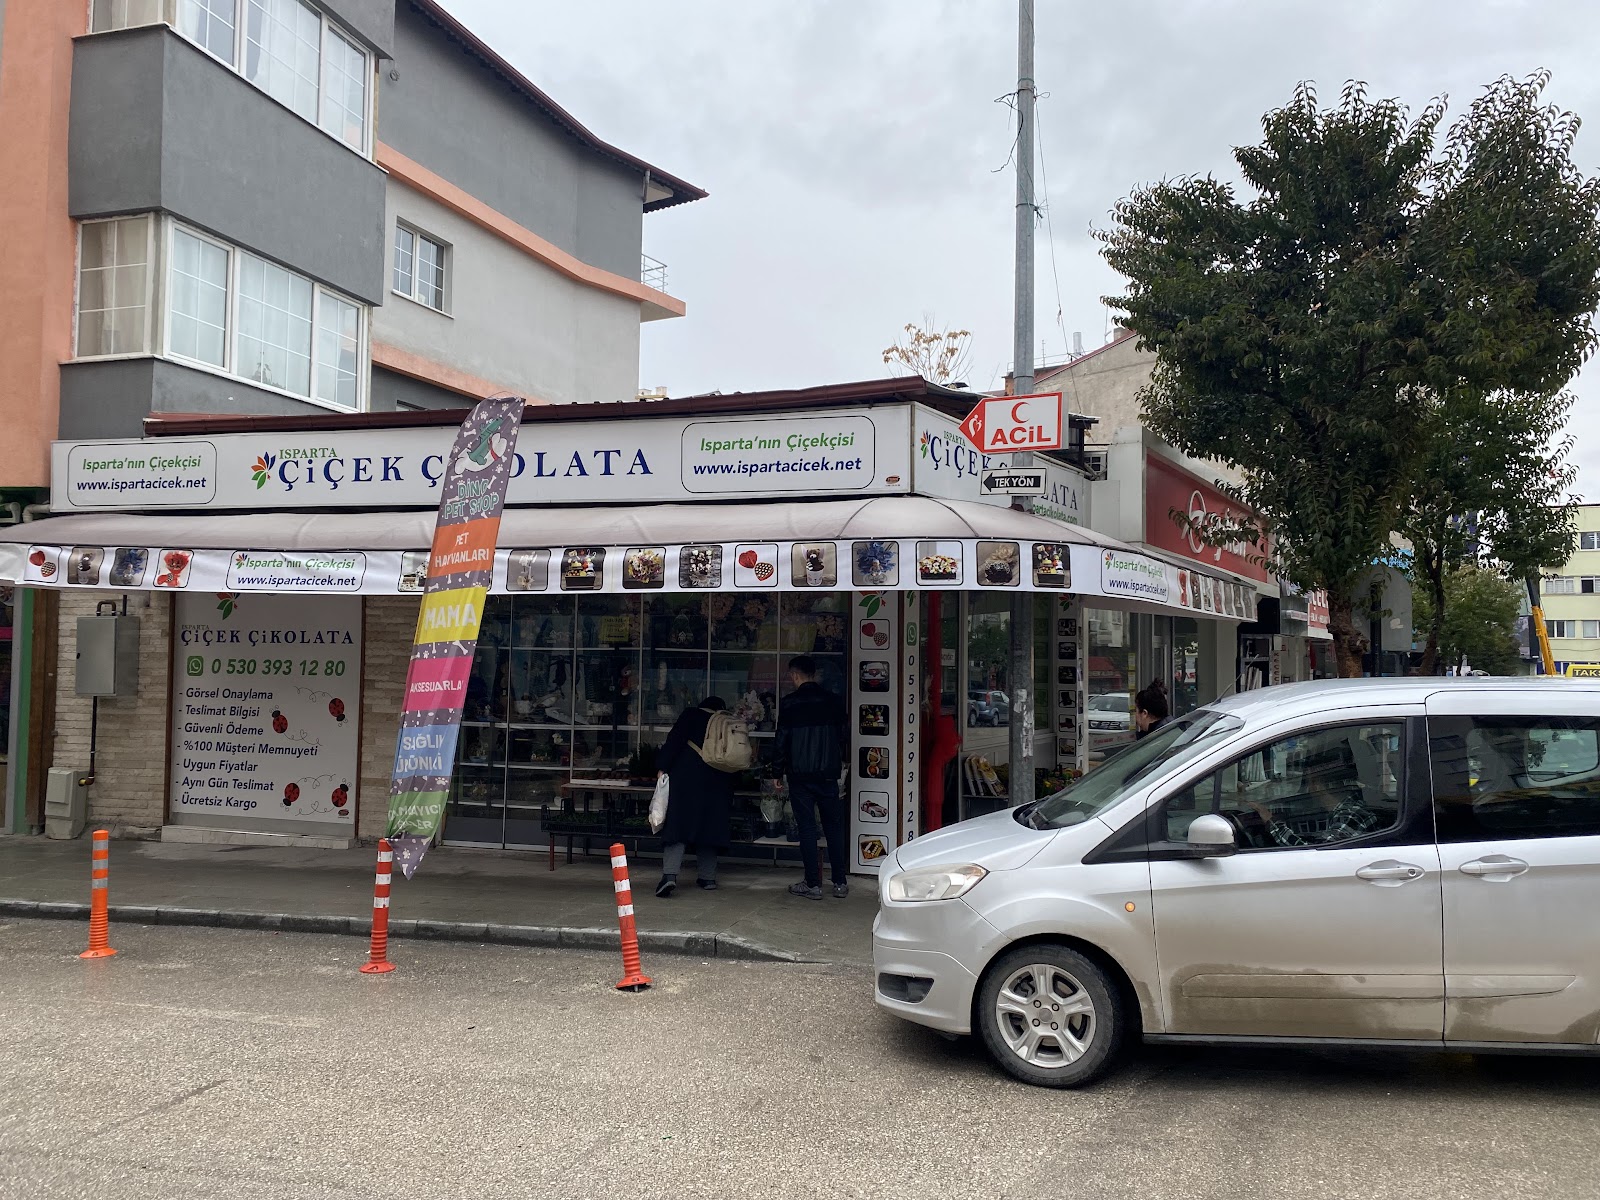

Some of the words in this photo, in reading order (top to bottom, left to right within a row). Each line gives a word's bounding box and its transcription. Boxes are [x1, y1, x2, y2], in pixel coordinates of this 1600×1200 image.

[786, 432, 855, 452] Çiçekçisi
[943, 430, 966, 447] ISPARTA
[279, 447, 338, 460] ISPARTA
[149, 455, 202, 472] Çiçekçisi
[421, 448, 653, 488] ÇOLATA
[693, 457, 862, 477] www.ispartacicek.net
[77, 477, 207, 493] www.ispartacicek.net
[994, 478, 1010, 488] TEK
[1011, 475, 1035, 487] YÖN
[444, 503, 465, 519] PET
[470, 493, 500, 516] SHOP
[455, 532, 470, 546] PET
[304, 558, 356, 571] Çiçekçisi
[237, 574, 356, 588] www.ispartacicek.net
[1109, 578, 1167, 597] www.ispartacicek.net
[424, 603, 478, 631] MAMA
[211, 658, 222, 674] 0
[226, 658, 257, 675] 530
[261, 659, 293, 676] 393
[299, 659, 319, 676] 12
[324, 660, 346, 676] 80
[1574, 669, 1600, 677] TAK
[185, 687, 219, 699] Görsel
[222, 688, 273, 704] Onaylama
[185, 705, 226, 717] Teslimat
[229, 706, 260, 720] Bilgisi
[184, 722, 223, 734] Güvenli
[226, 721, 264, 735] Ödeme
[183, 740, 213, 752] %100
[215, 741, 255, 755] Müşteri
[258, 743, 318, 758] Memnuyeti
[183, 758, 216, 772] Uygun
[218, 759, 258, 774] Fiyatlar
[181, 776, 205, 790] Aynı
[207, 776, 229, 789] Gün
[232, 778, 275, 791] Teslimat
[181, 792, 223, 807] Ücretsiz
[225, 796, 258, 811] Kargo
